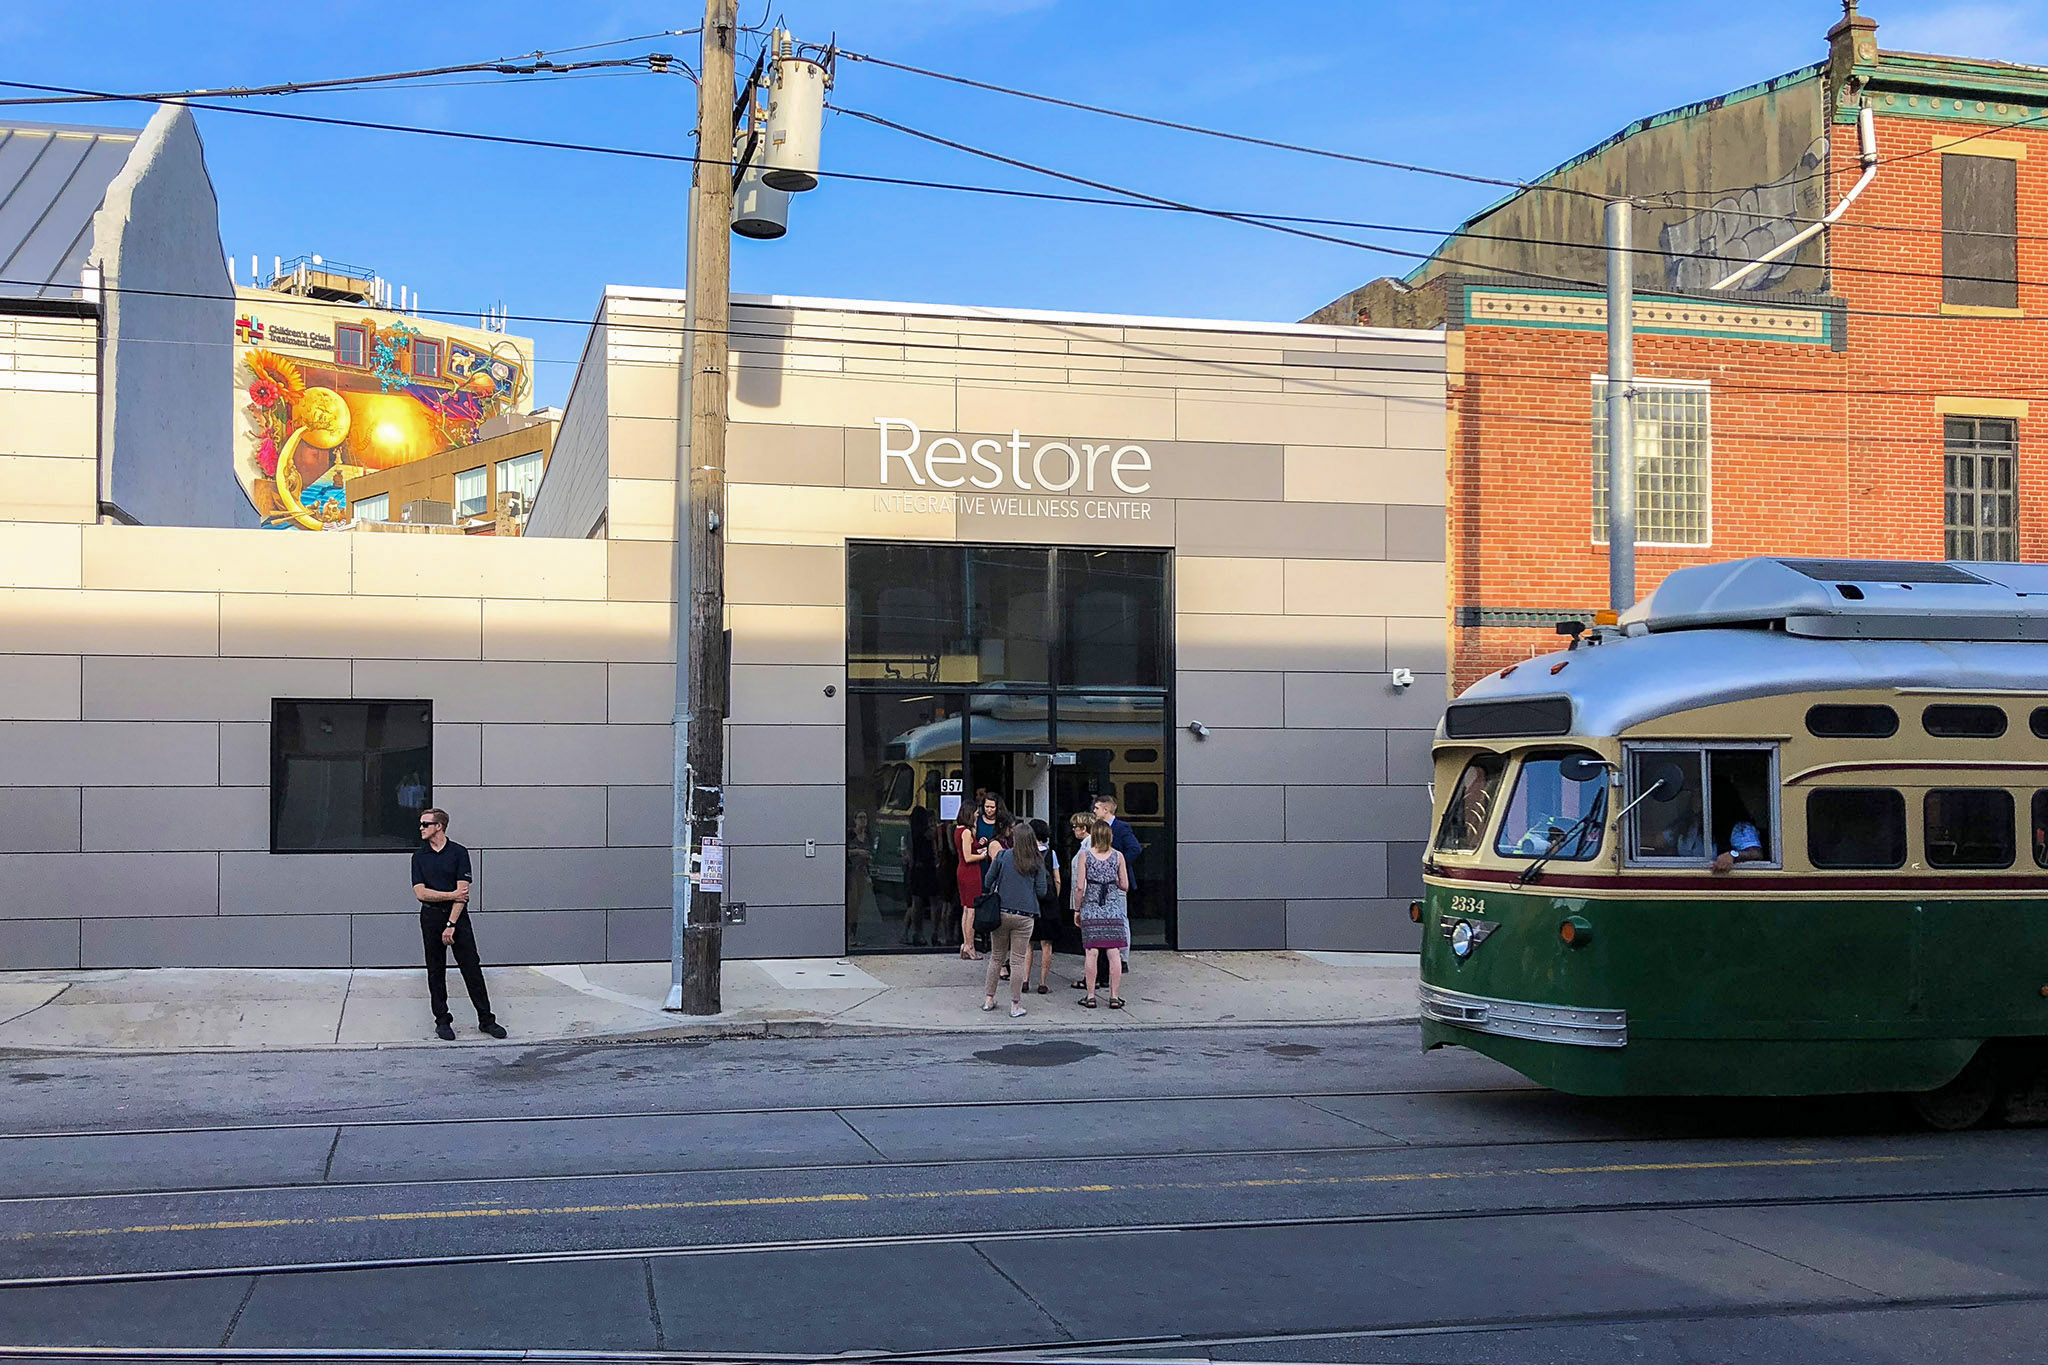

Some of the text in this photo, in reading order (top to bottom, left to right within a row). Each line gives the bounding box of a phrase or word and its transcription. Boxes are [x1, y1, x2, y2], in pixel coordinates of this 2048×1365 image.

[268, 325, 331, 343] Children's Crisis
[269, 333, 336, 351] Treatment Center
[874, 416, 1152, 494] Restore
[873, 494, 1151, 520] INTEGRATIVE WELLNESS CENTER
[942, 780, 961, 791] 957
[1451, 895, 1485, 914] 2334
